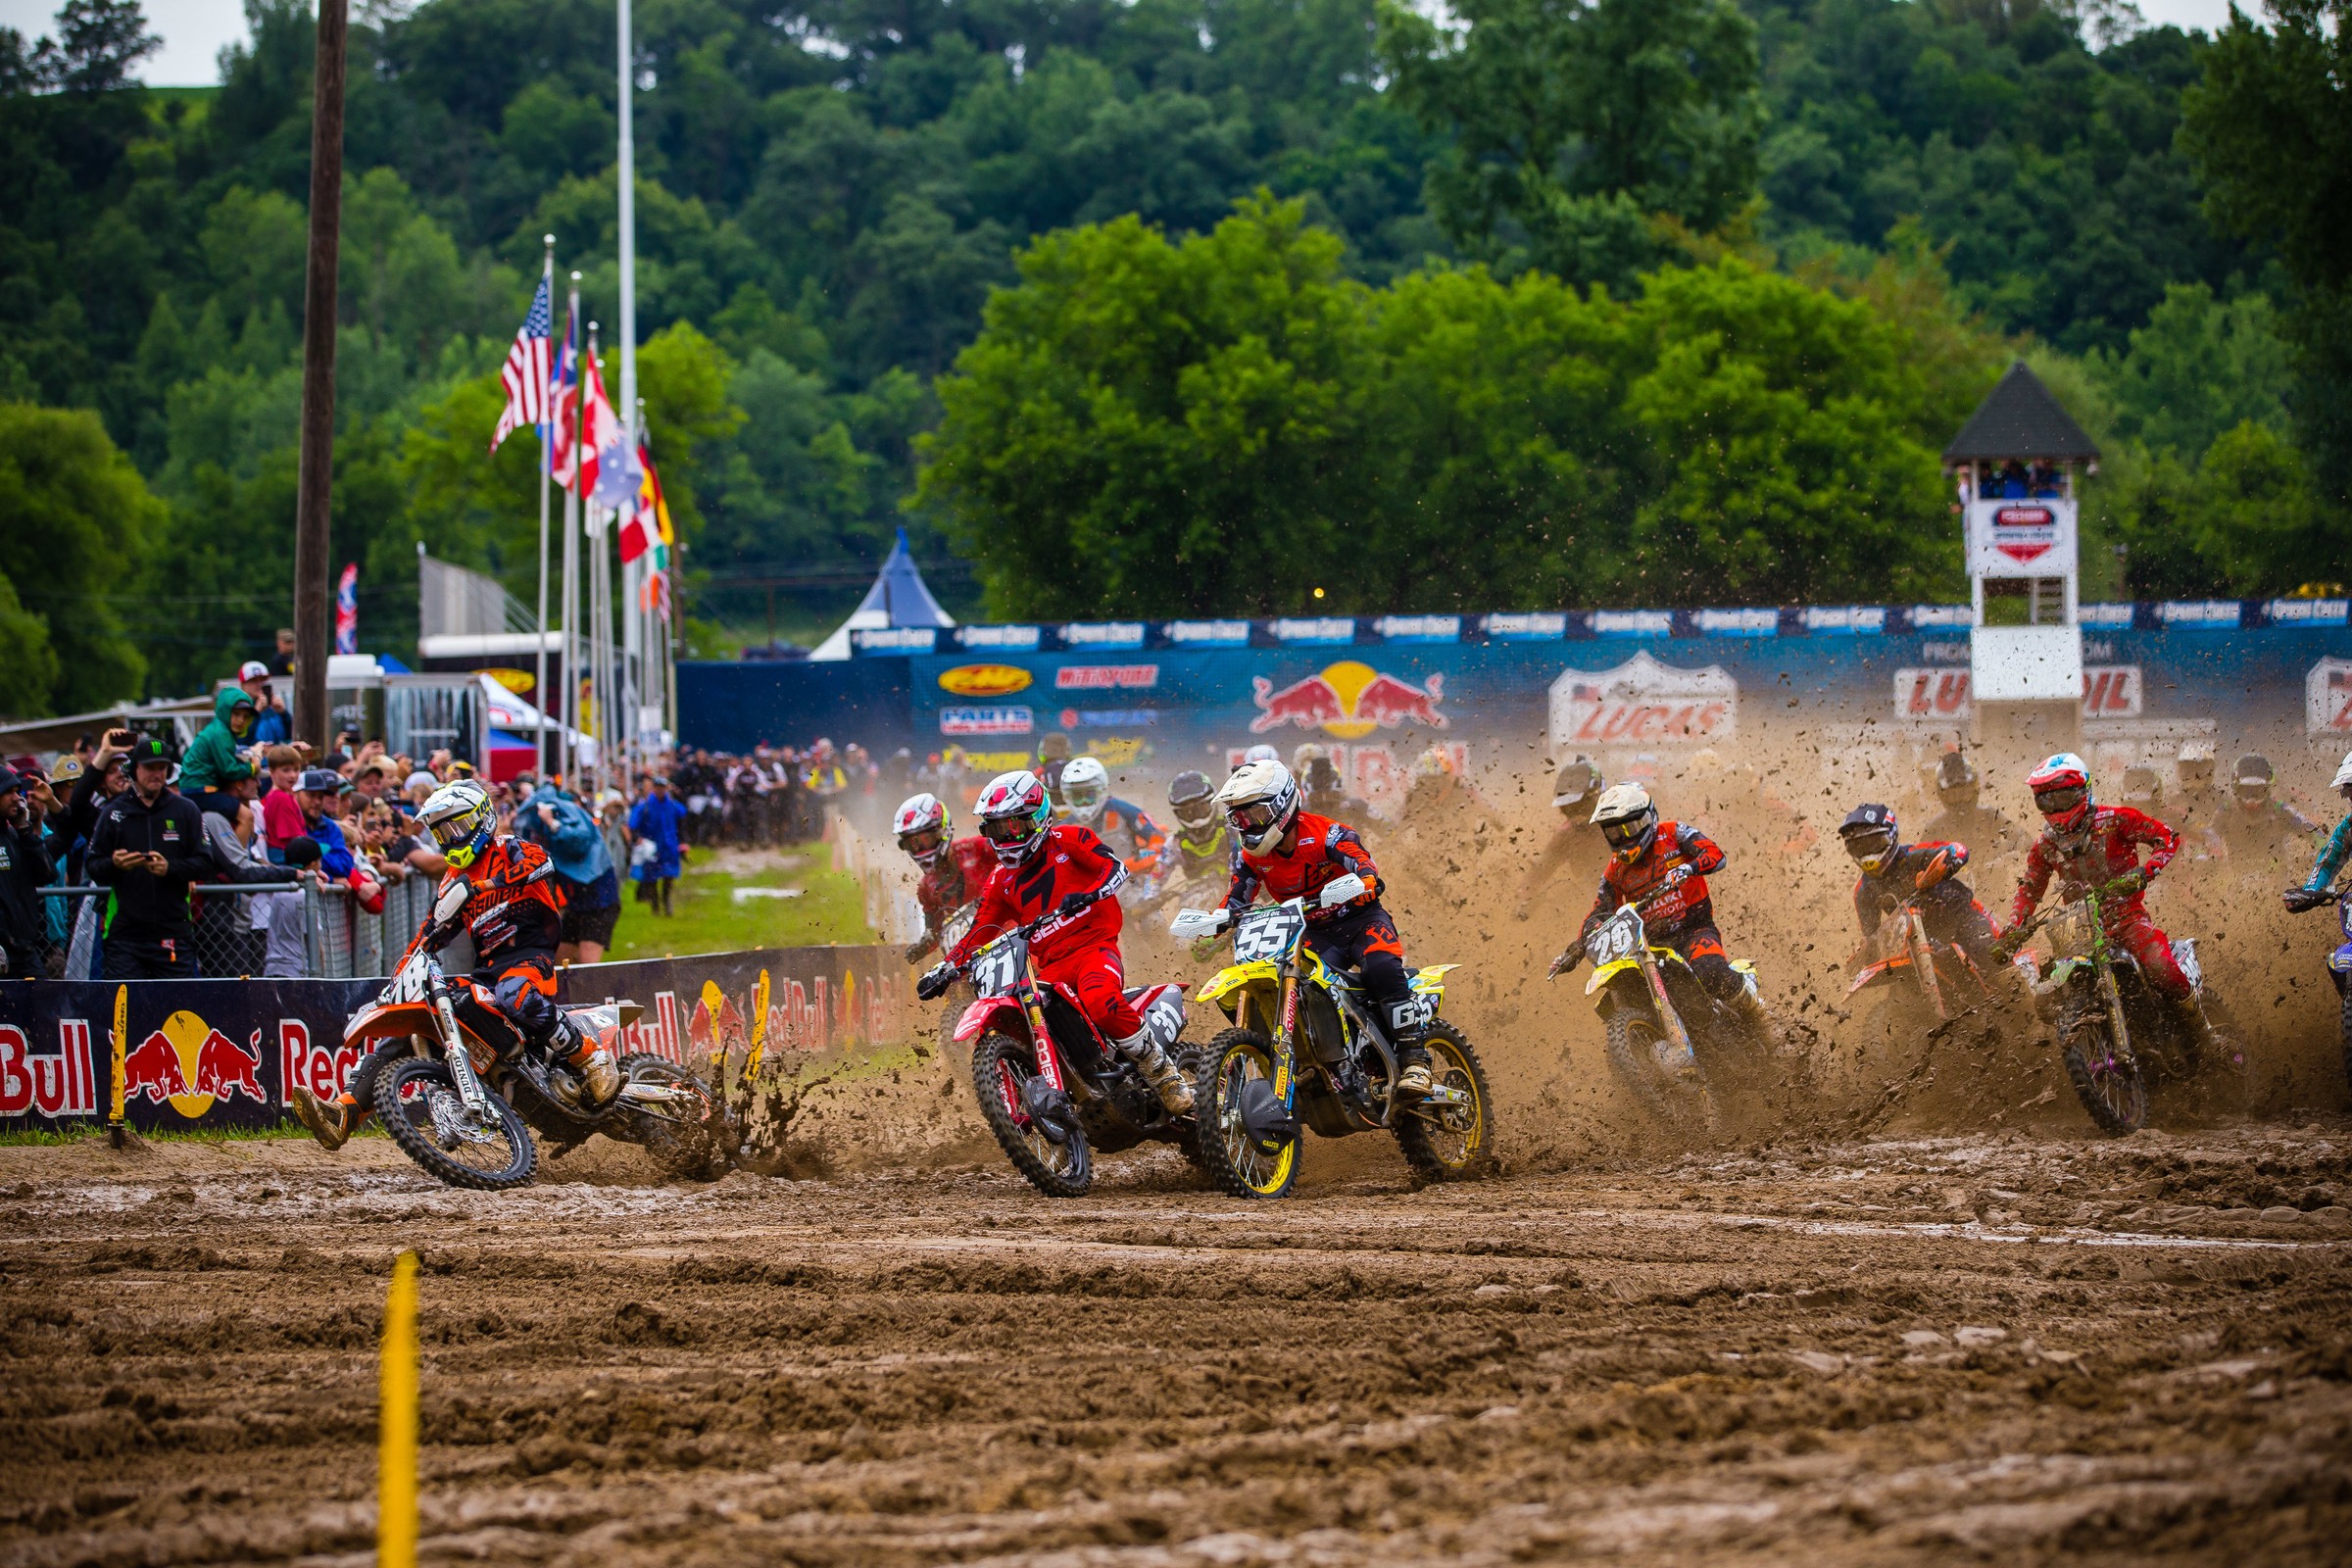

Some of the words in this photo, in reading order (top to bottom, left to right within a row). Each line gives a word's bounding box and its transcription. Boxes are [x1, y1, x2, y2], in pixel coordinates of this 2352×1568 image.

[943, 709, 1028, 721] PARTS
[1573, 705, 1725, 740] LUCAS
[1030, 905, 1092, 944] GEICO
[1236, 915, 1299, 956] 55
[1252, 911, 1269, 921] LUCAS
[975, 947, 1018, 1000] 31
[1151, 1001, 1183, 1043] 31
[1285, 990, 1298, 1032] SHOWA
[0, 1019, 97, 1116] Bull
[1036, 1039, 1057, 1090] GEICO
[1276, 1068, 1288, 1100] PIRELLI
[637, 1085, 655, 1094] EBC
